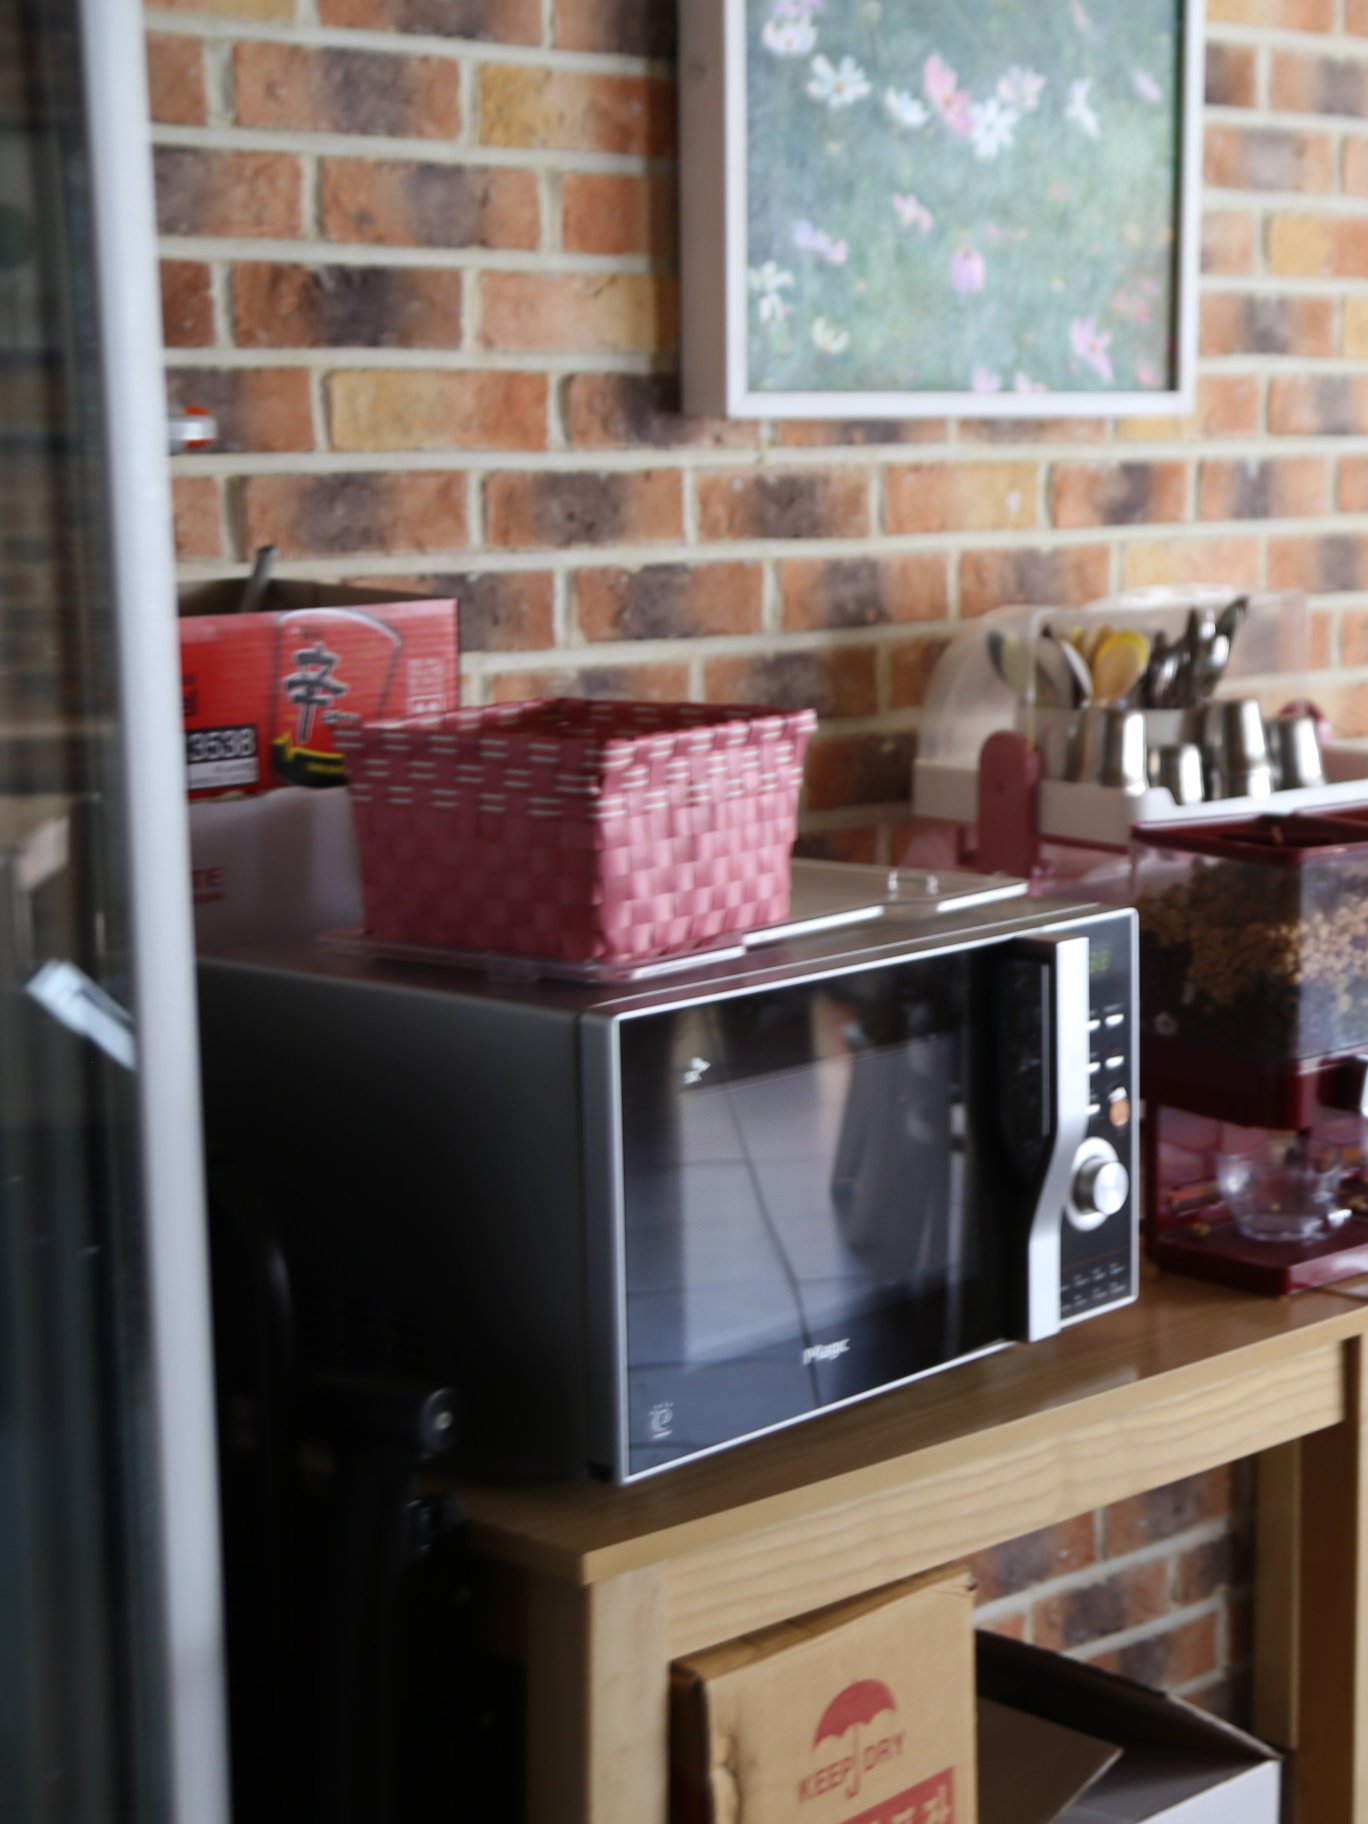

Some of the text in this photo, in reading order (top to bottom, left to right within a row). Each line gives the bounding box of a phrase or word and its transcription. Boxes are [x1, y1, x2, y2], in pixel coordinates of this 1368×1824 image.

[284, 641, 349, 744] 辛
[797, 1729, 905, 1803] KEEP DRY
